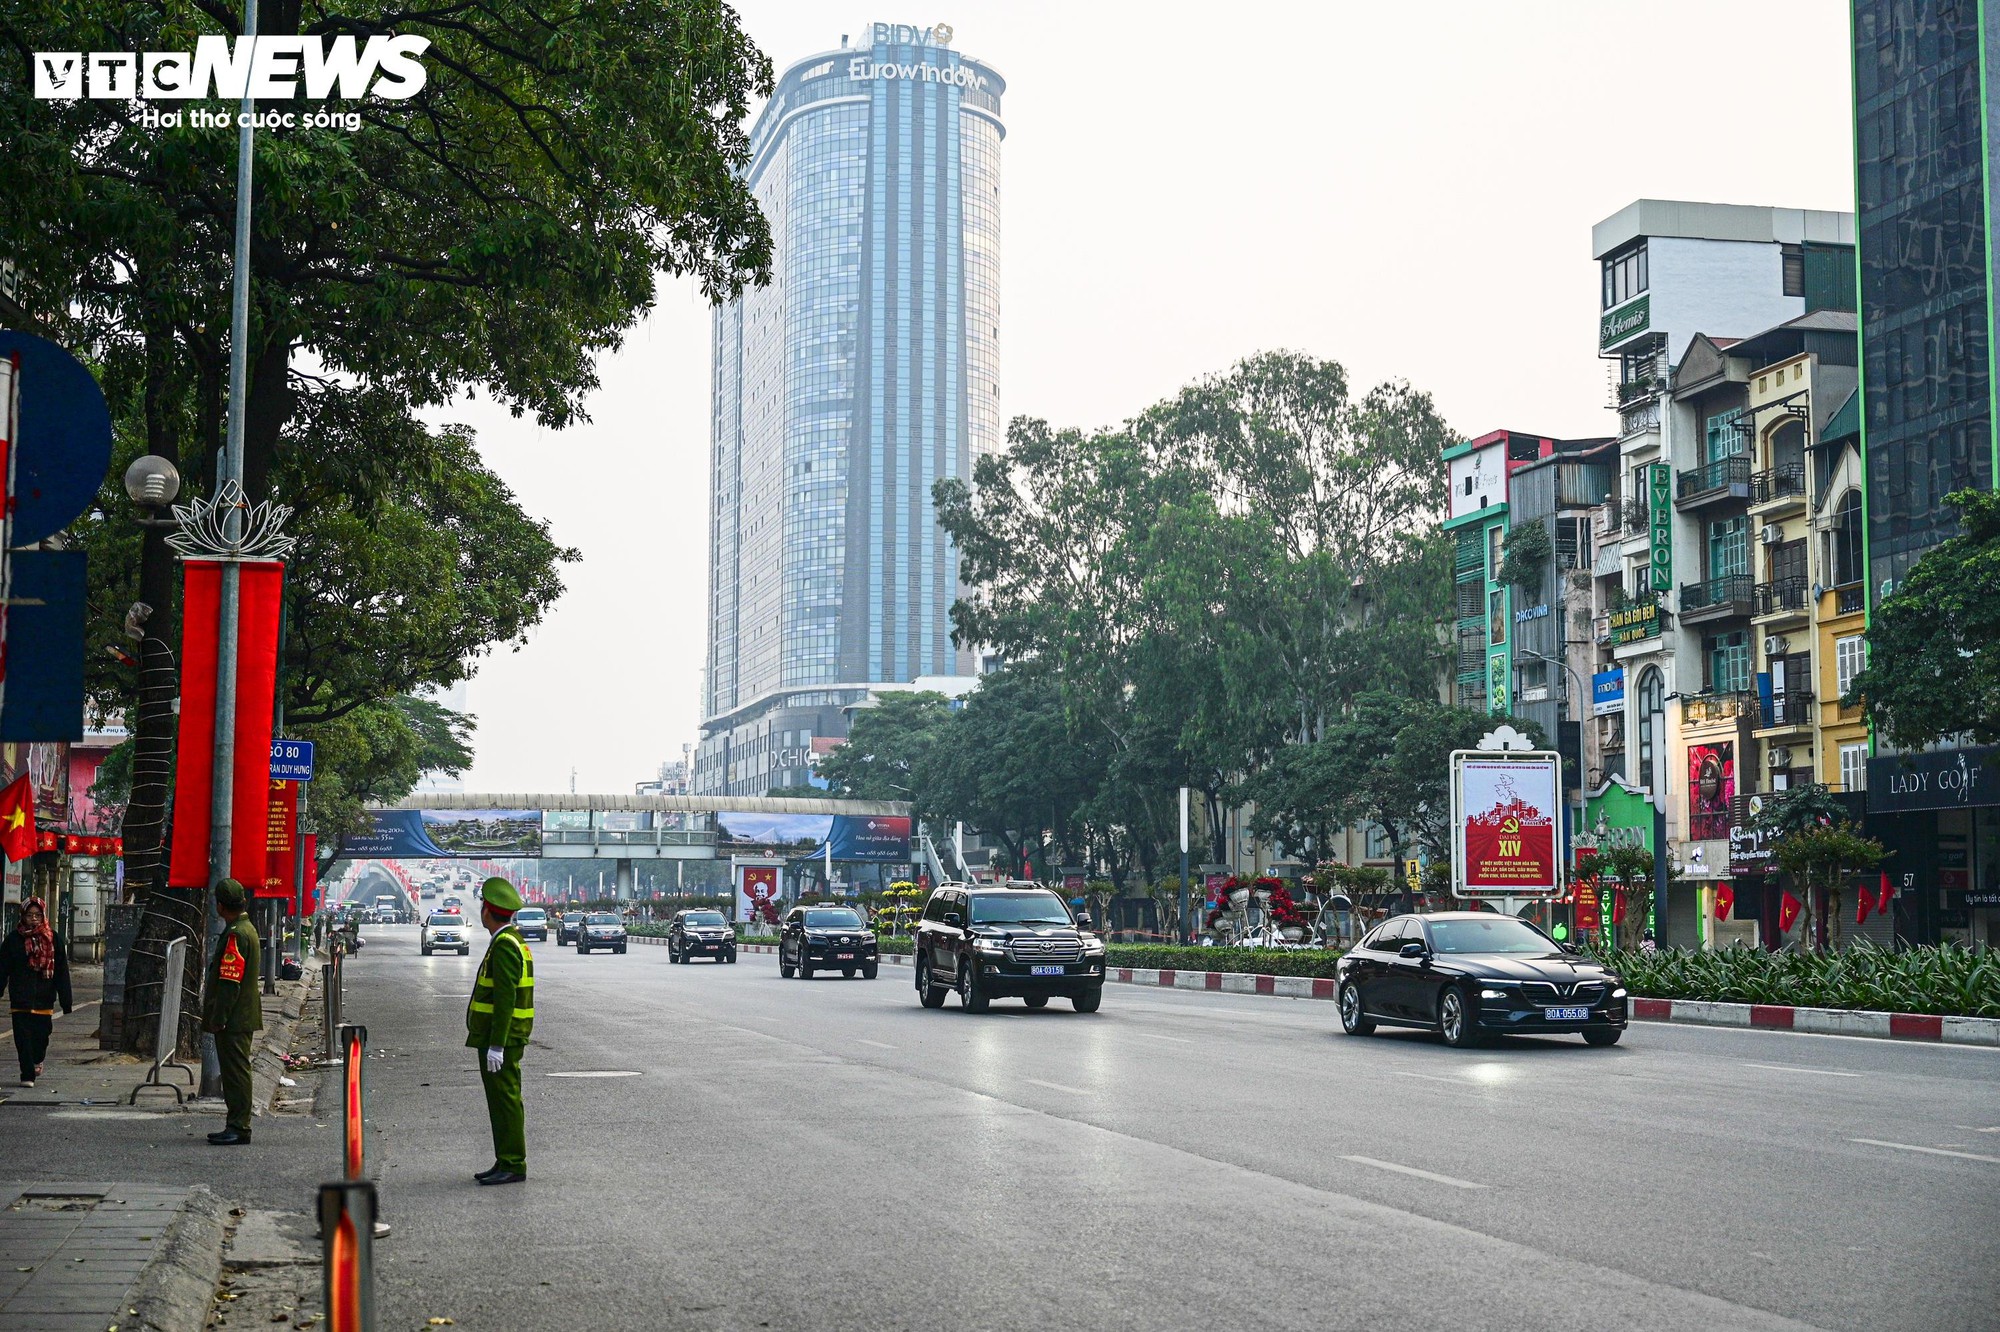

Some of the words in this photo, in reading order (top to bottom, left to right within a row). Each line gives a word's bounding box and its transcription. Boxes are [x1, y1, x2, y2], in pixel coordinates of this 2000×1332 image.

[873, 22, 933, 46] BIDV
[849, 57, 985, 91] Eurowindow
[1653, 468, 1670, 584] EVERON
[1516, 603, 1548, 623] DACOVINA
[270, 743, 283, 758] GÕ
[286, 746, 299, 758] 80
[281, 764, 293, 774] DUY
[293, 764, 310, 775] HƯNG
[1890, 772, 1930, 794] LADY
[1498, 840, 1521, 857] XIV
[1904, 873, 1914, 887] 57
[1965, 894, 1973, 905] Uy
[1546, 1009, 1587, 1019] 80A-055.08
